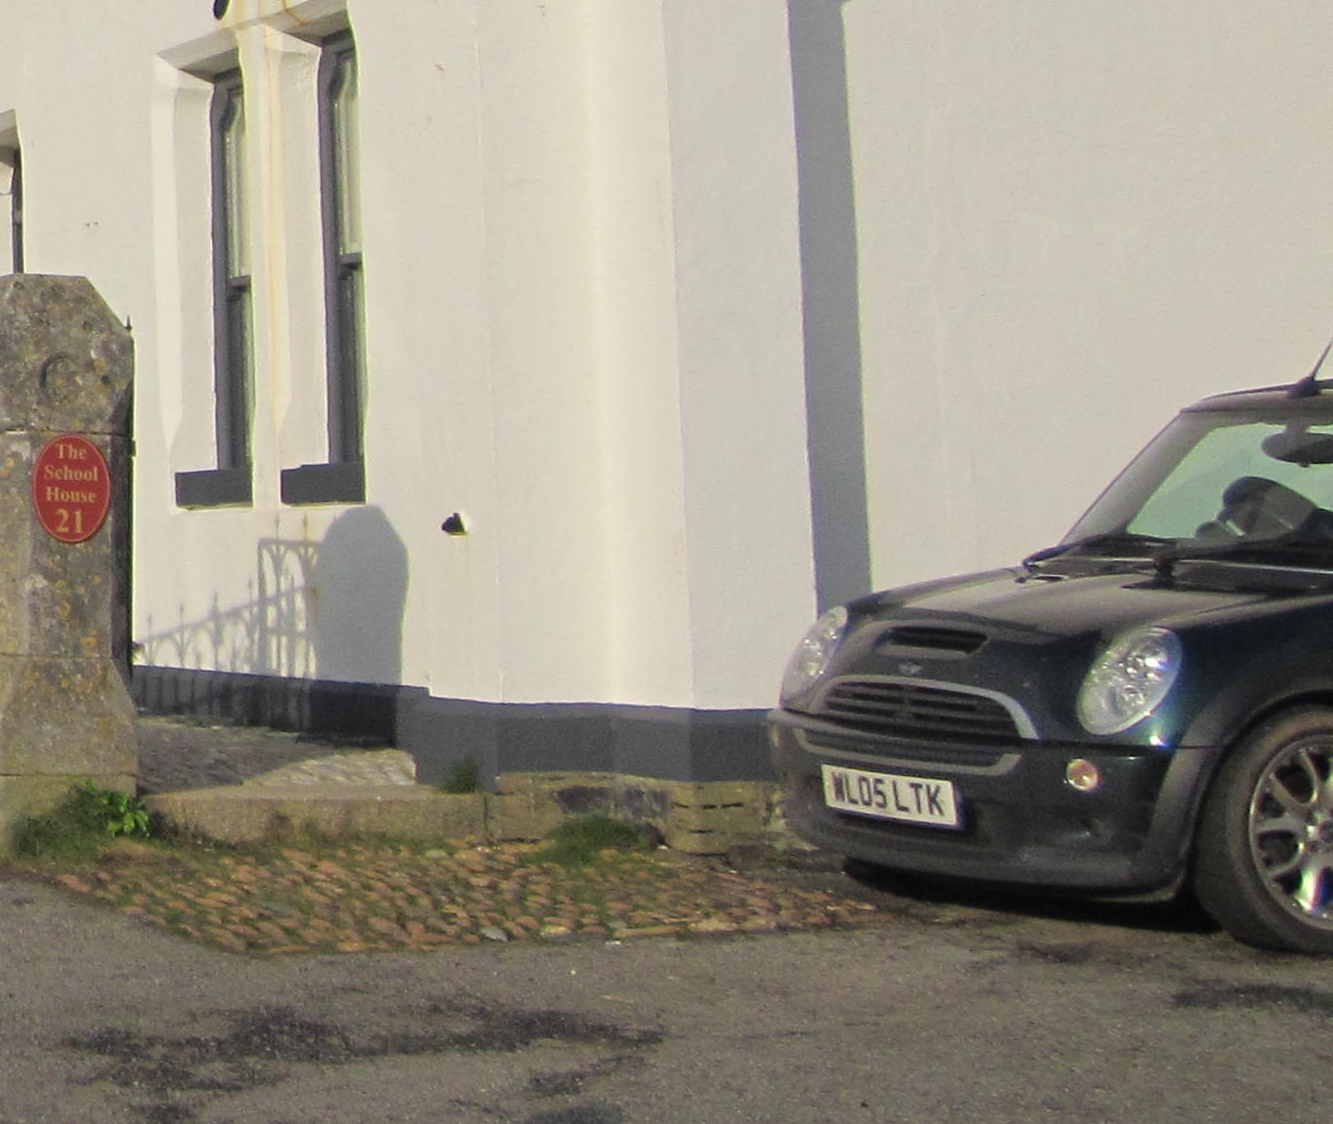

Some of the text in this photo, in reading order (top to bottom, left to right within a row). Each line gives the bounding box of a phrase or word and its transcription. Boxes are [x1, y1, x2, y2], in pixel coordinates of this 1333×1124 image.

[56, 443, 87, 460] The
[44, 464, 98, 482] School
[46, 486, 97, 504] House
[55, 507, 84, 533] 21
[830, 771, 946, 817] WL05 LTK
